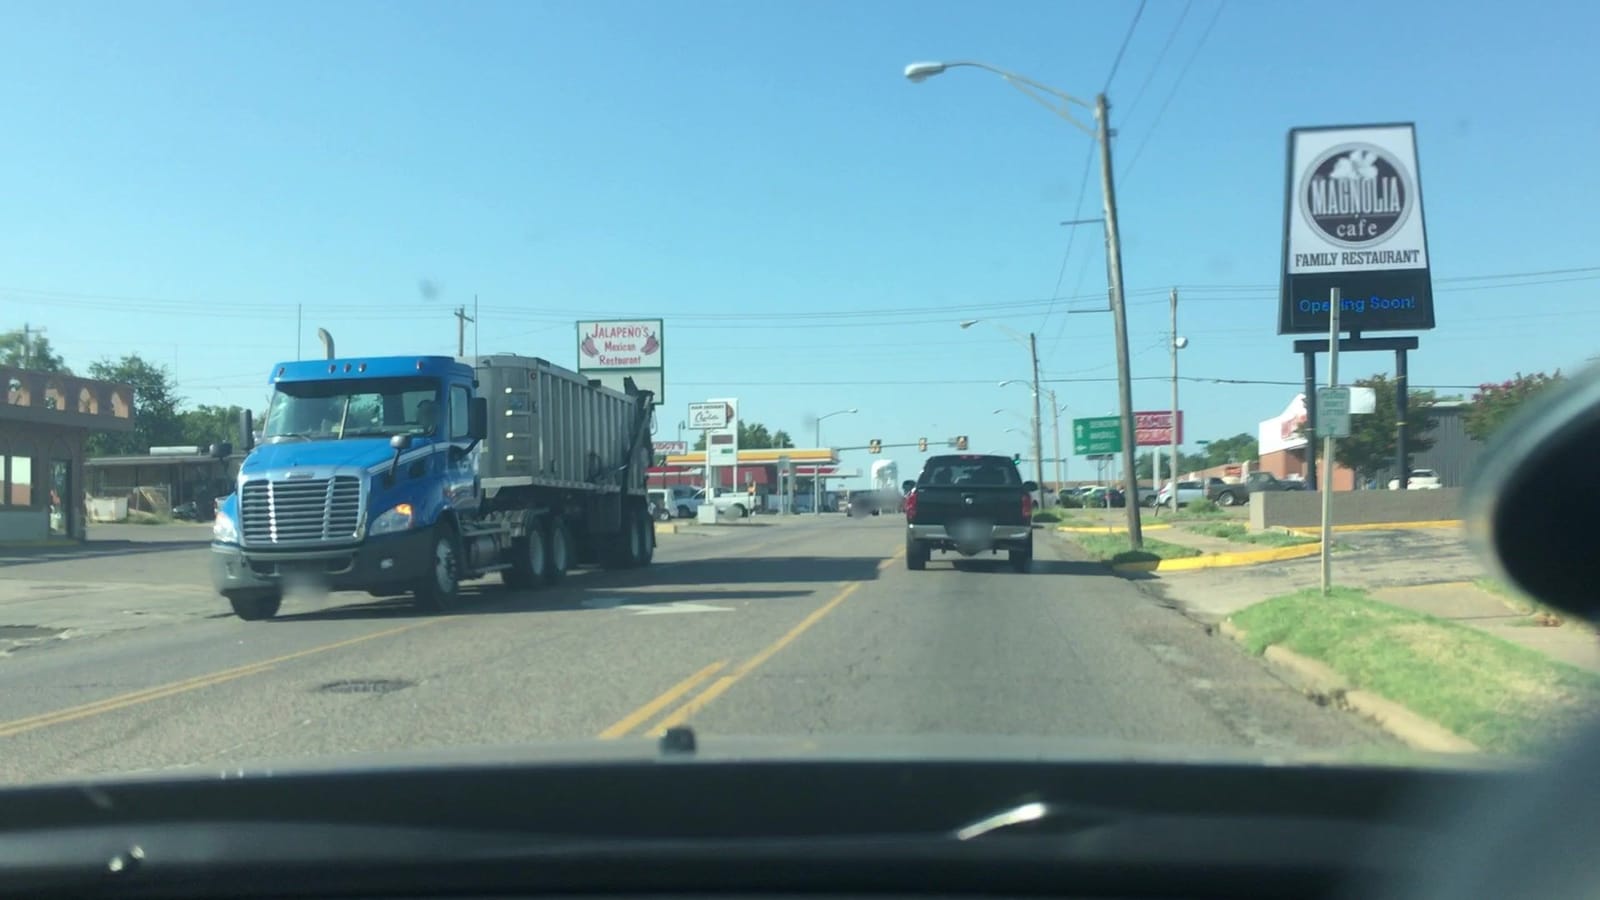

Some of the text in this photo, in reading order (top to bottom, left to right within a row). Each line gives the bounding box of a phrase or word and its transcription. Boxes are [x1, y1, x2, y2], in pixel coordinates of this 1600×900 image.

[1311, 176, 1401, 216] MAGNOLIA
[1336, 219, 1378, 237] cafe
[1295, 249, 1420, 267] FAMILY RESTAURANT
[1299, 295, 1416, 315] Opeing Soon!
[604, 341, 636, 352] Mexican
[599, 355, 641, 366] Restaurant
